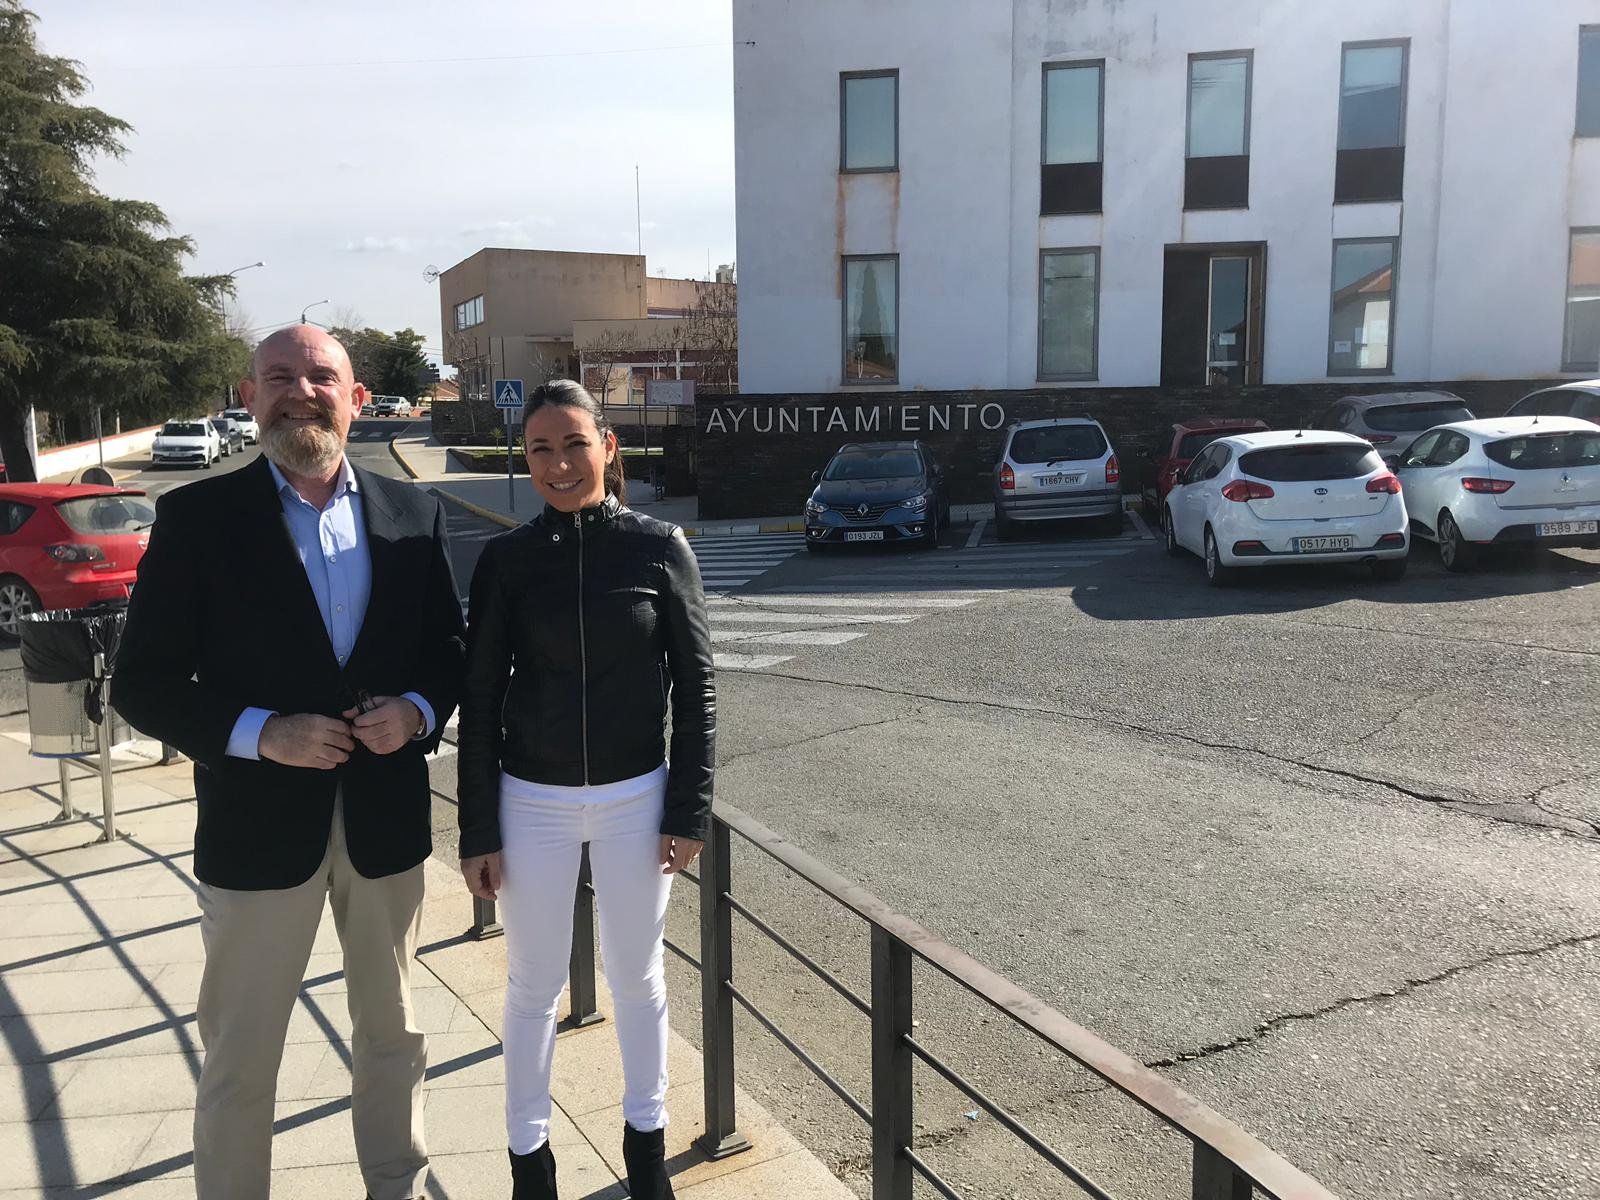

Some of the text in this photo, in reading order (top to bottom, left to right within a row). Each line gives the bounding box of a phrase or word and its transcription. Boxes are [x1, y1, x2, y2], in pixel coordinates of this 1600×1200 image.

[705, 402, 1005, 433] AYUNTAMIENTO
[1543, 521, 1595, 534] 9589 JFG
[1300, 537, 1350, 549] 0517 HYB
